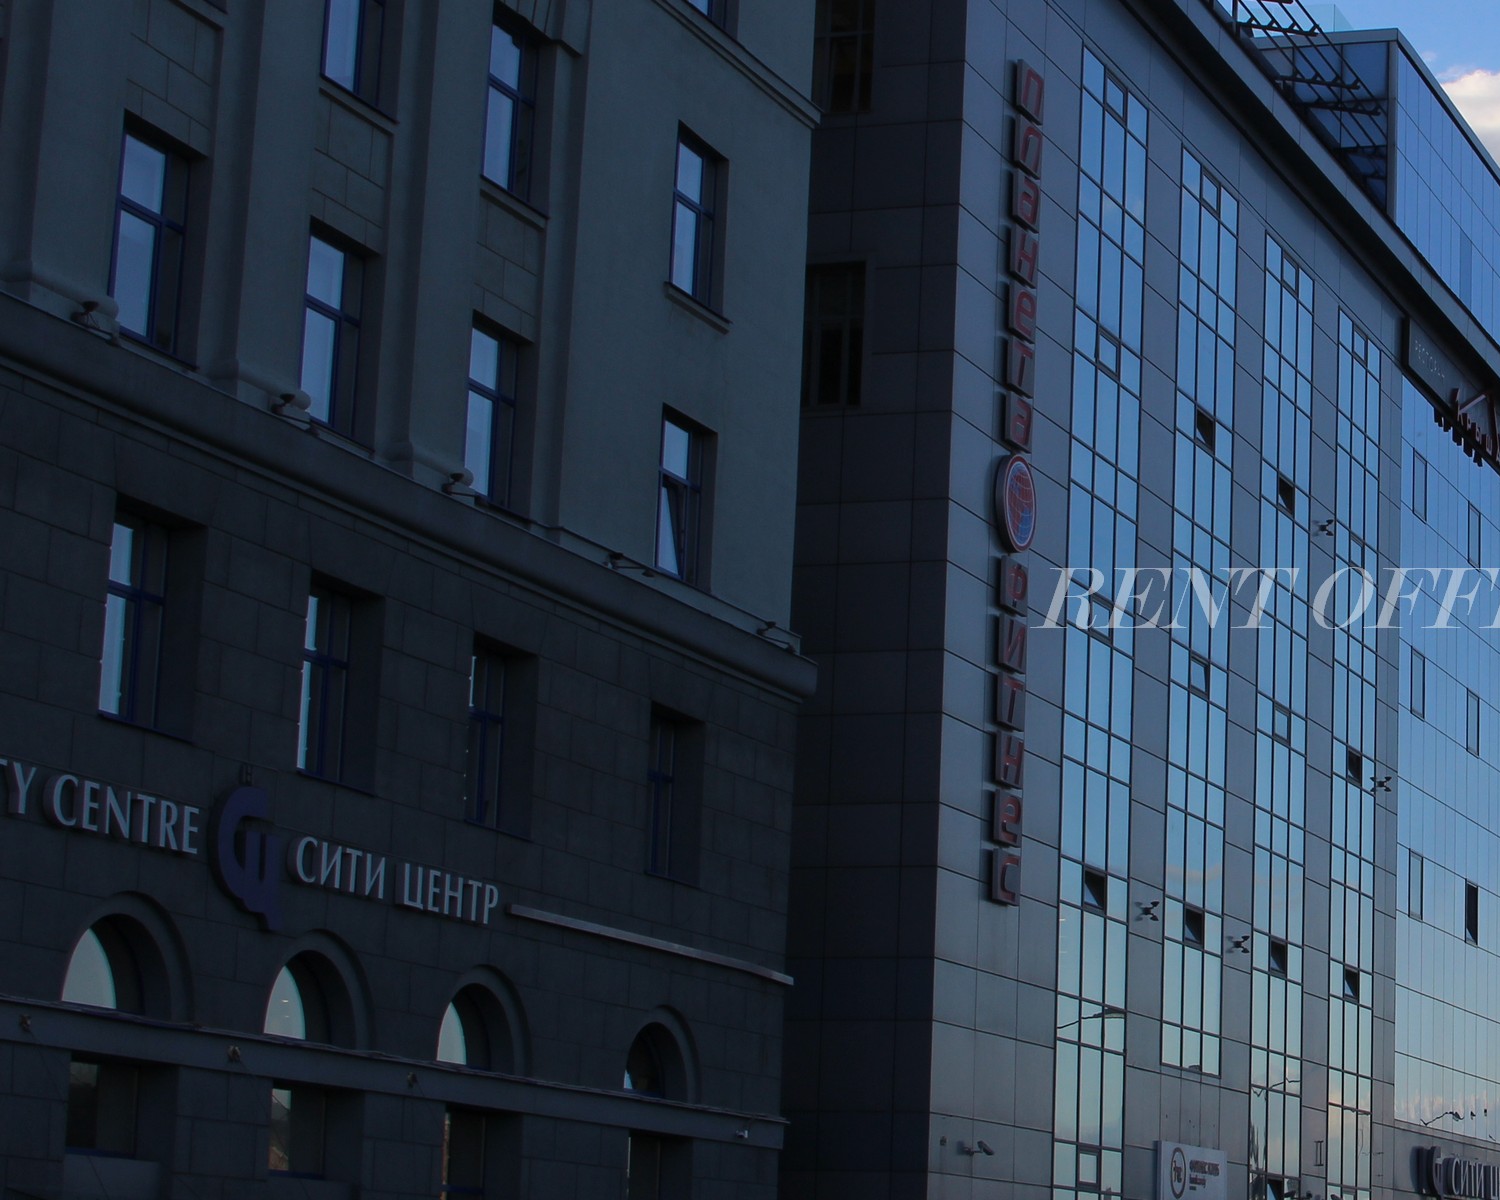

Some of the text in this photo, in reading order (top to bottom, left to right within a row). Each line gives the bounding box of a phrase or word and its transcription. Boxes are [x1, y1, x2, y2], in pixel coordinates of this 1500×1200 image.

[53, 774, 199, 855] CENTRE
[296, 836, 499, 925] СИТИ ЦЕНТР
[1452, 1158, 1485, 1199] СИТИ
